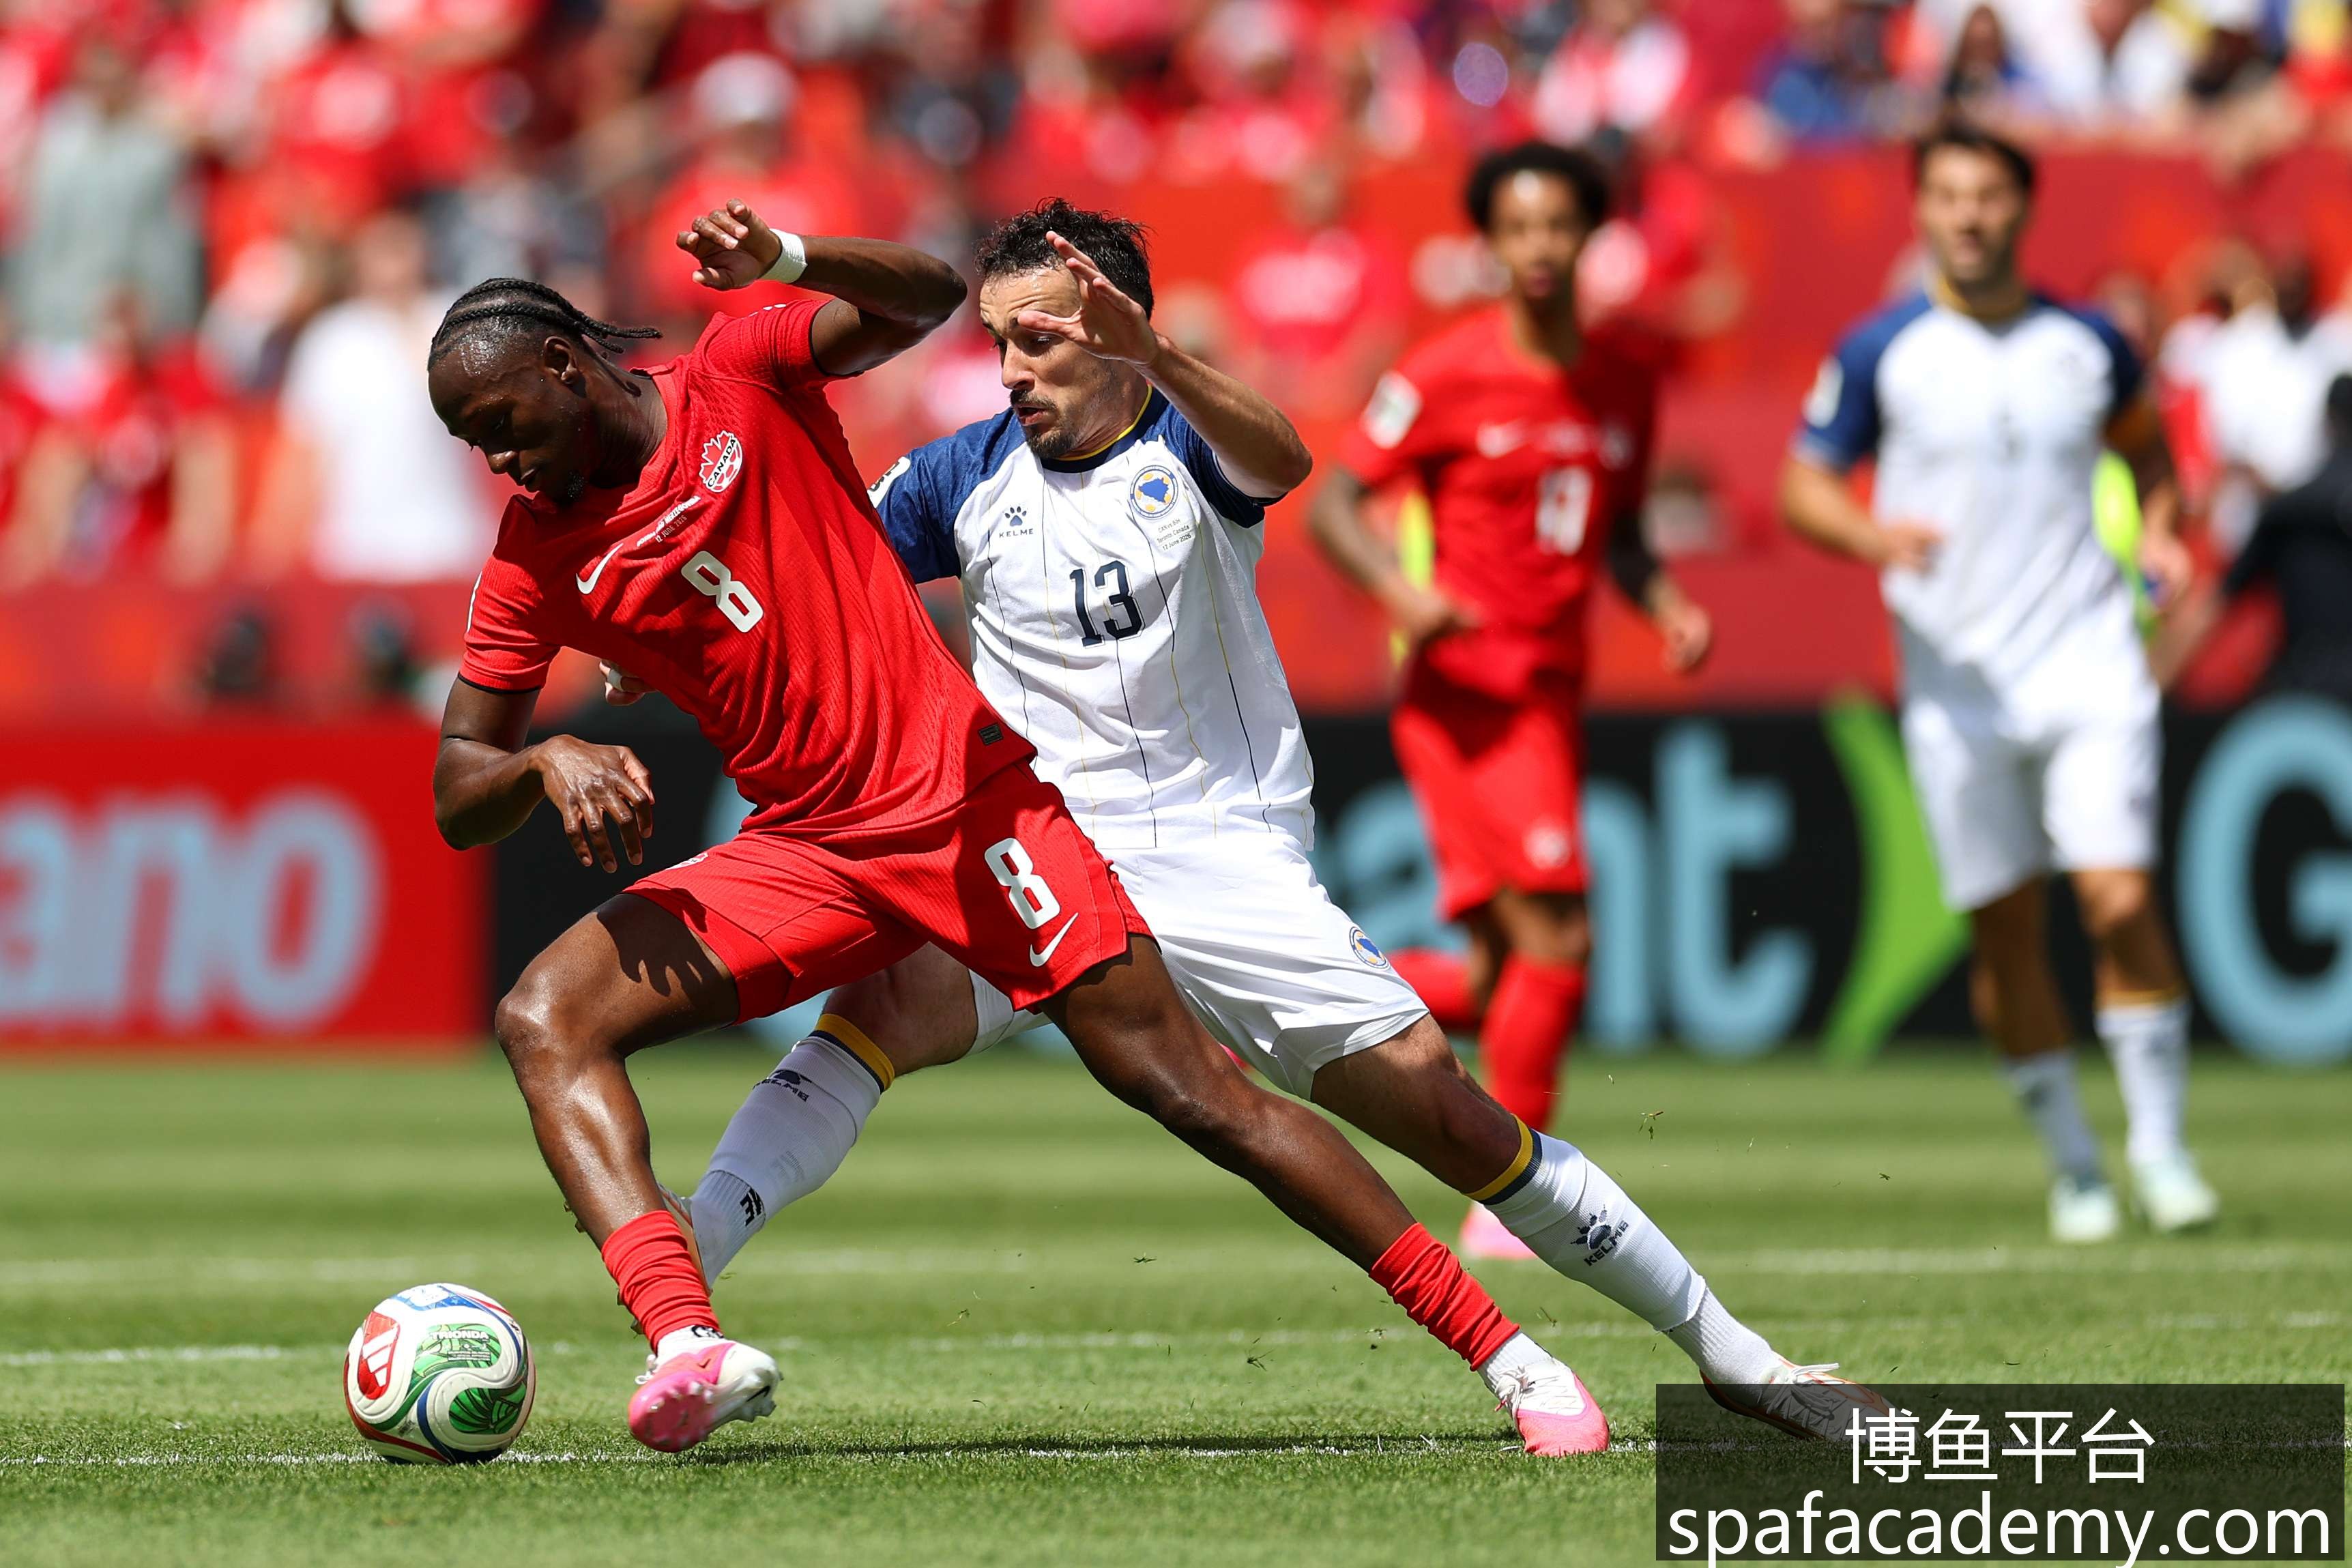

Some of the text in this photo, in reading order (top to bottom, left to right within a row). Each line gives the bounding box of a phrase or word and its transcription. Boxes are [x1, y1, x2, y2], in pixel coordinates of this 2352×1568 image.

[708, 439, 736, 487] CANADA
[661, 525, 676, 538] JUNE
[998, 528, 1034, 538] KELME
[681, 551, 764, 633] 8
[1069, 560, 1146, 648] 13
[984, 837, 1060, 930] 8
[753, 1079, 810, 1102] ELME
[1583, 1220, 1629, 1266] KELME
[429, 1330, 489, 1340] TRIONDA
